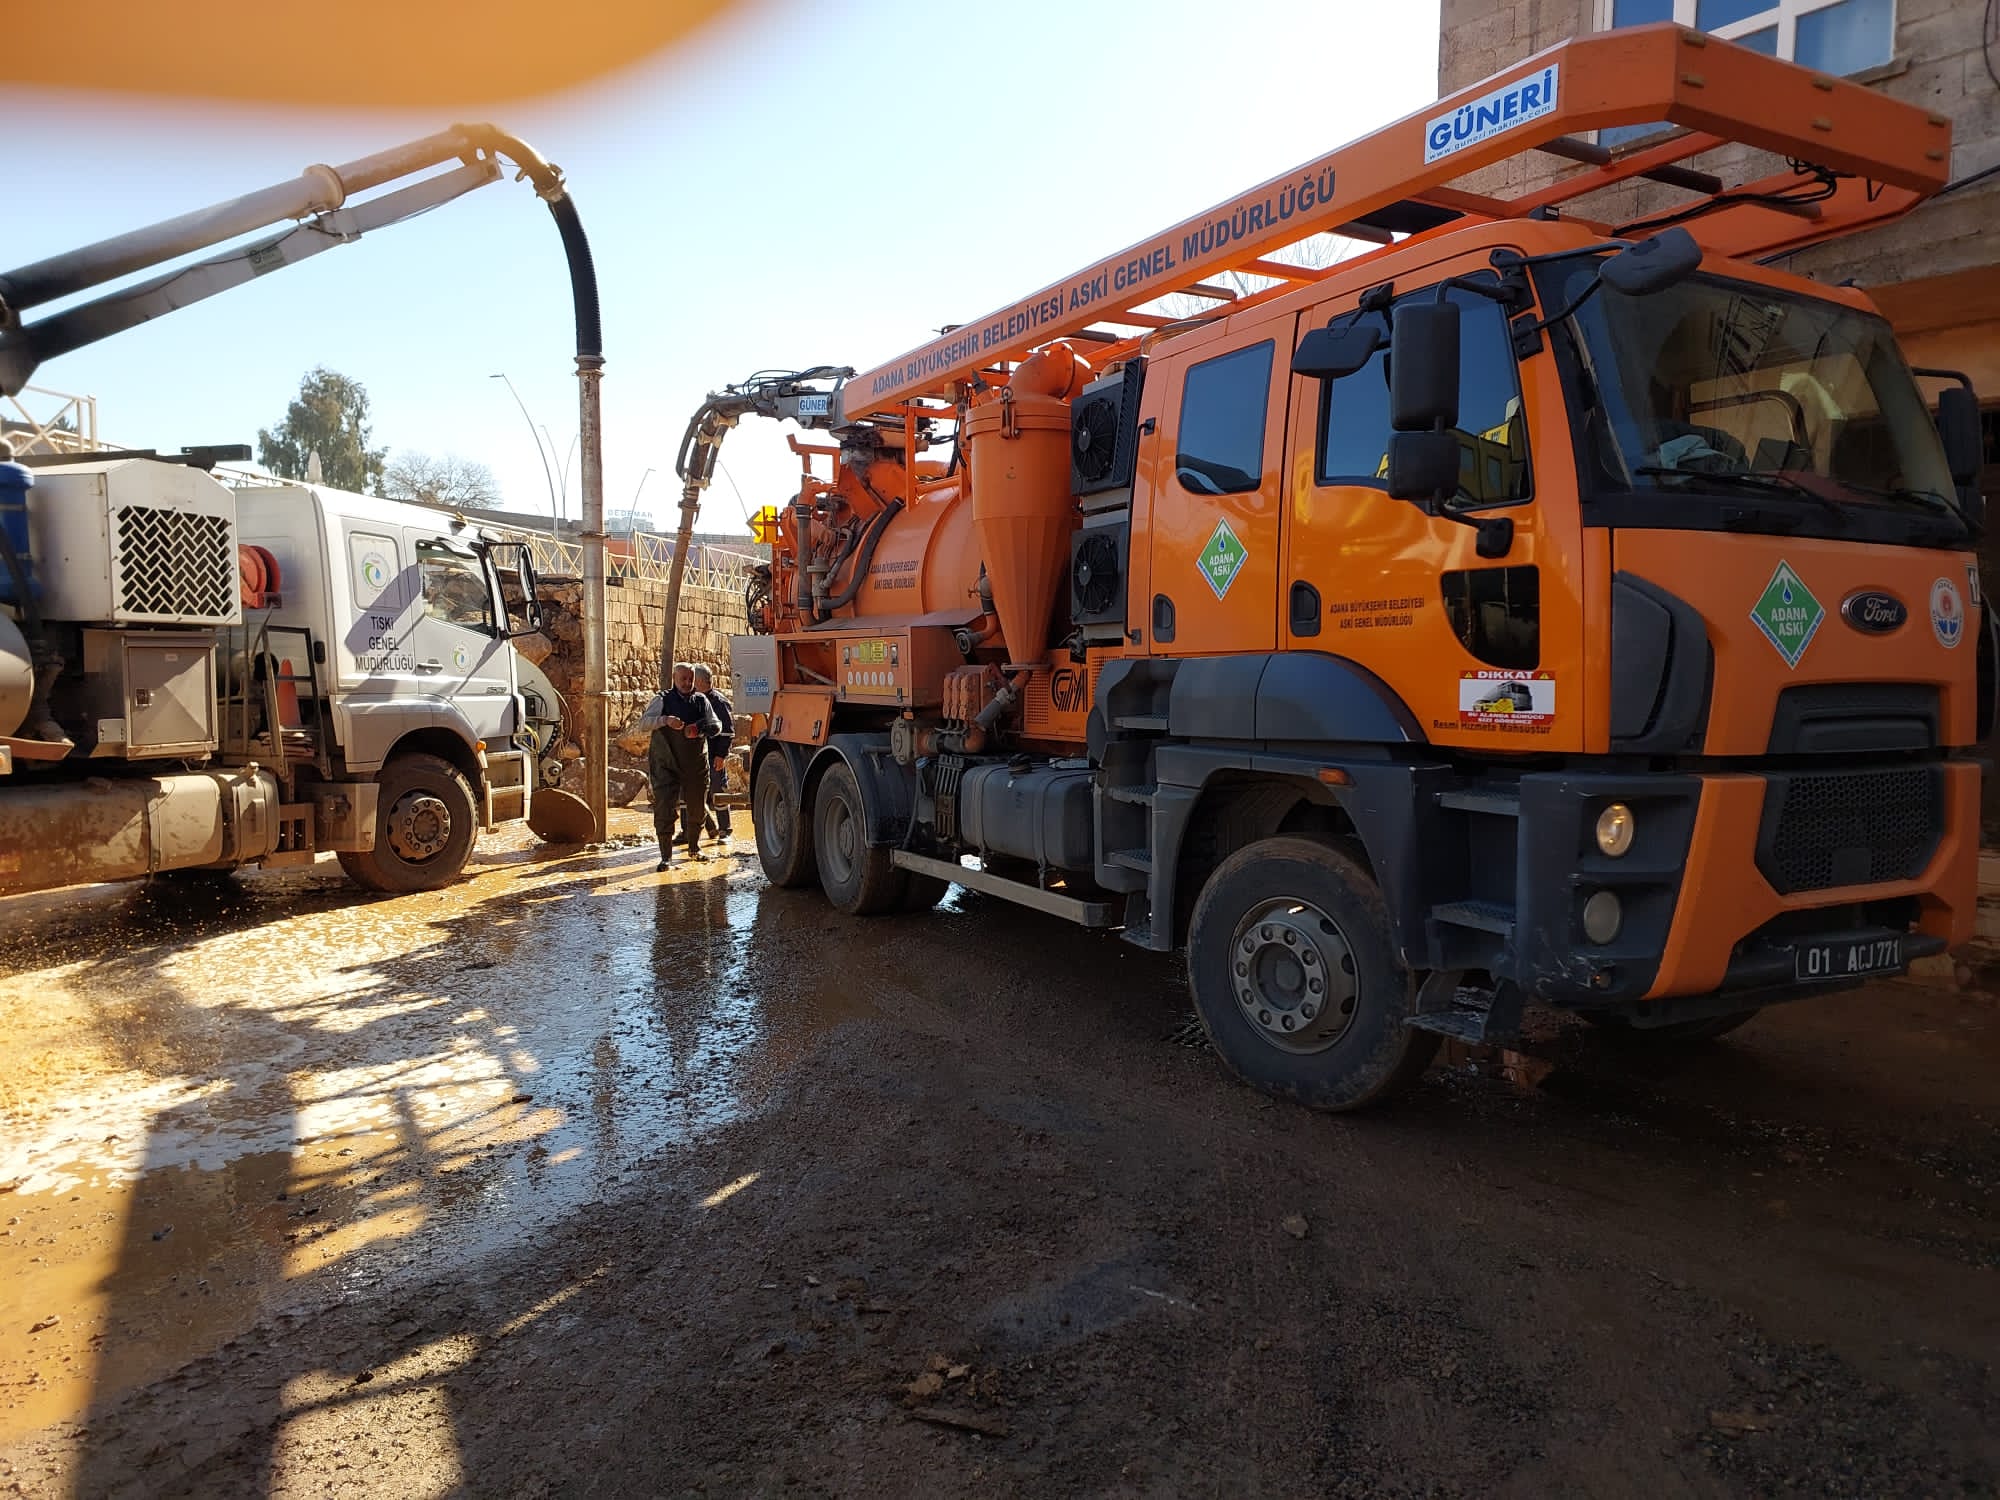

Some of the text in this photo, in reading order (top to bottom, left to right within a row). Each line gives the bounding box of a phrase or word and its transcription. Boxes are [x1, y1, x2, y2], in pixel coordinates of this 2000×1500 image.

[1429, 69, 1552, 150] GÜNERİ
[872, 165, 1336, 396] ADANA BÜYÜKŞEHİR BELEDİYESİ ASKİ GENEL MÜDÜRLÜĞÜ
[1209, 552, 1234, 567] ADANA
[1330, 603, 1349, 614] ADANA
[1771, 607, 1808, 622] ADANA
[1863, 597, 1898, 623] Ford
[1355, 617, 1373, 628] GENEL
[369, 636, 399, 650] GENEL
[355, 654, 414, 671] MÜDÜRLÜĞÜ
[1433, 720, 1458, 728] Resmi
[1808, 948, 1830, 974] 01
